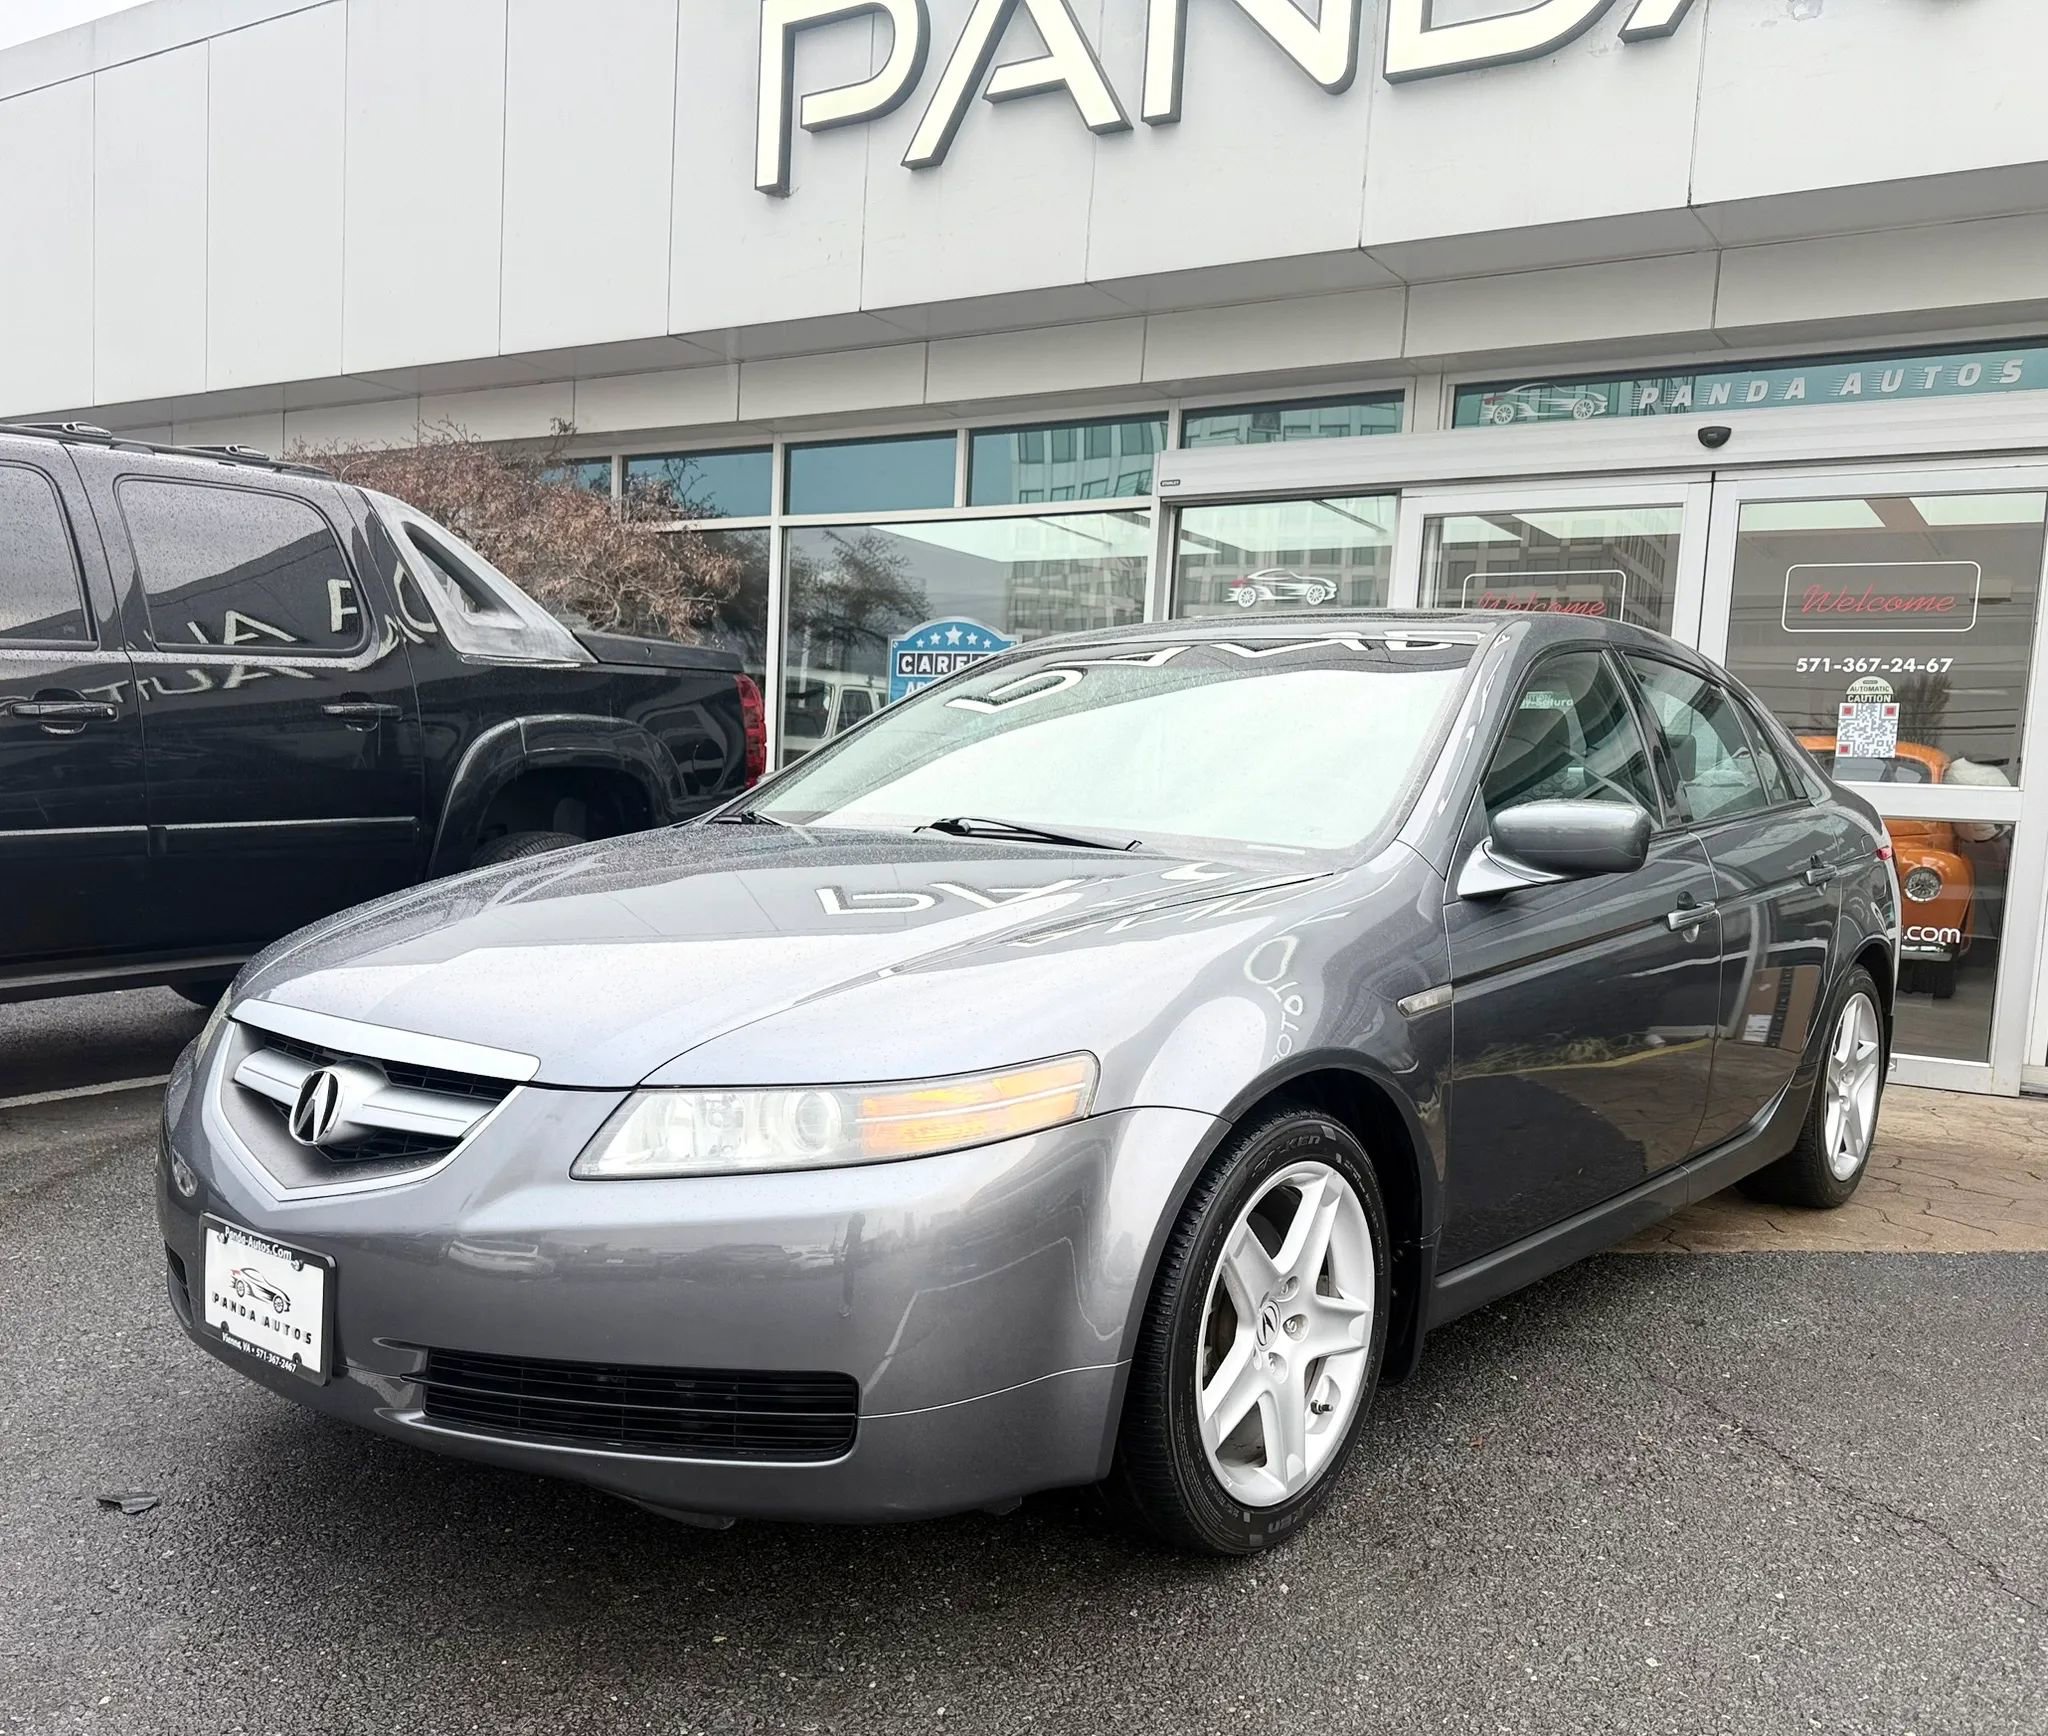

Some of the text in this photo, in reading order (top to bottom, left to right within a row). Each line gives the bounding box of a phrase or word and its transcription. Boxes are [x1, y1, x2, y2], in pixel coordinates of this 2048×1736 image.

[754, 0, 1695, 198] PAN
[1636, 358, 2026, 411] PANDA AUTOS
[1801, 582, 1957, 615] Welcome
[900, 655, 983, 673] CARF
[1795, 657, 1954, 673] 571-367-24-67
[1847, 694, 1892, 703] CAUTION
[1850, 685, 1890, 693] AUTOMATIC
[1902, 926, 1961, 944] .com
[212, 1292, 312, 1345] PANDA AUTOS
[255, 1347, 297, 1373] 571-367-2467
